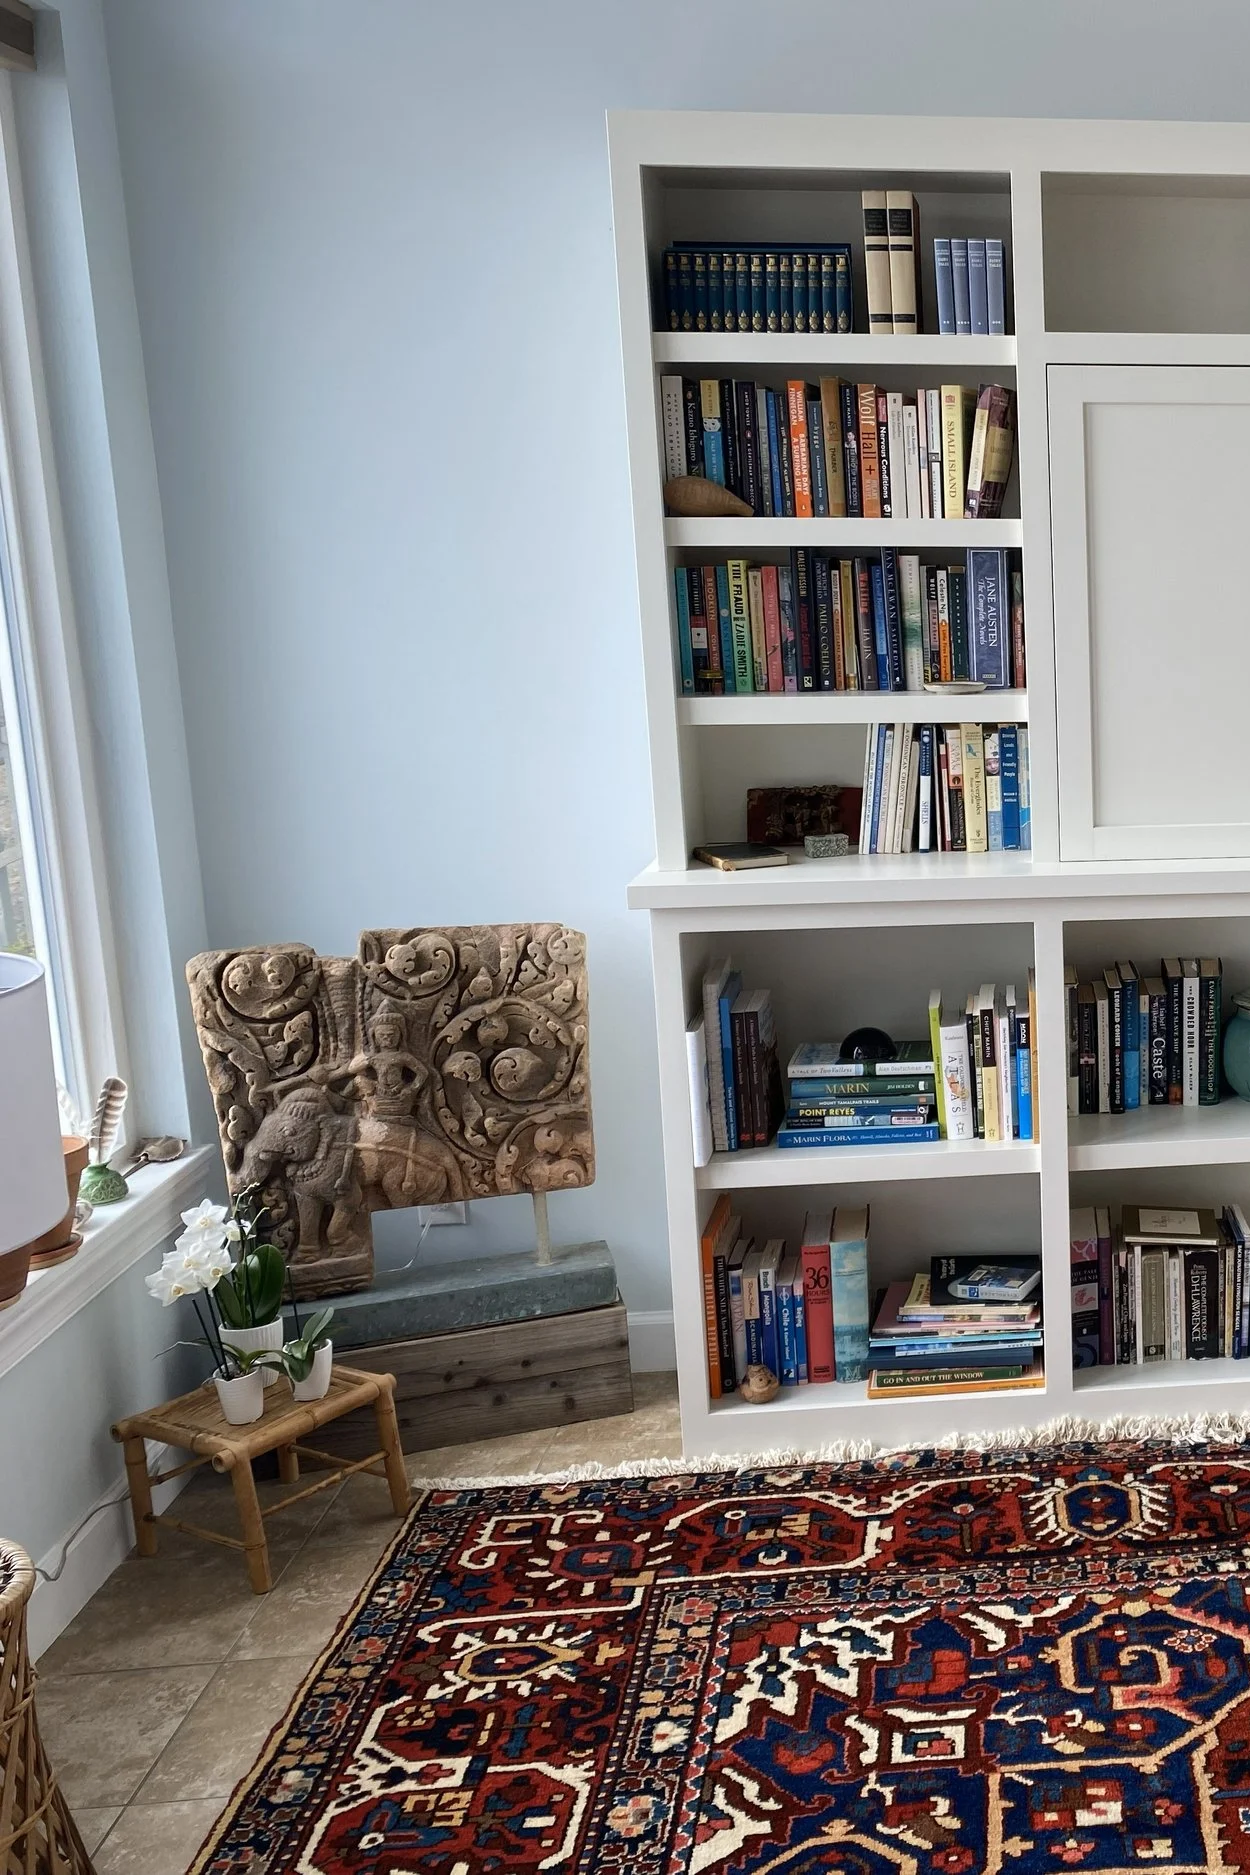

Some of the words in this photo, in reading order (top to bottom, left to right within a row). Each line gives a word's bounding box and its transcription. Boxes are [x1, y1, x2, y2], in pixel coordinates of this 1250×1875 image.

[687, 402, 696, 427] Kazuo
[790, 388, 798, 426] FINNEGAN
[796, 390, 804, 422] WILLIAM
[860, 390, 875, 426] Wolf
[688, 429, 698, 461] Ishiguro
[863, 432, 877, 460] Hall
[947, 420, 955, 457] SMALL
[793, 445, 801, 476] SURFING
[799, 433, 808, 475] BARBARIAN
[881, 459, 890, 499] Conditions
[948, 459, 957, 499] ISLAND
[732, 563, 741, 581] THE
[797, 551, 806, 571] KHALED
[885, 551, 893, 569] IAN
[706, 577, 715, 621] BROOKLYN
[798, 572, 807, 598] HOSSEINI
[887, 574, 896, 619] McEWAN
[977, 579, 985, 593] The
[985, 576, 996, 603] JANE
[733, 584, 744, 615] FRAUD
[939, 604, 947, 614] Ng
[976, 594, 986, 622] Complete
[819, 604, 828, 635] PAULO
[987, 605, 998, 647] AUSTEN
[736, 624, 746, 649] ZADIE
[979, 623, 987, 646] Novels
[737, 650, 748, 678] SMITH
[821, 636, 831, 676] COELHO
[891, 628, 900, 672] SATURDAY
[902, 735, 910, 770] DOMINICAN
[899, 772, 907, 806] CHRONICLE
[974, 780, 983, 816] Everglades
[921, 801, 929, 825] SHELLS
[1187, 996, 1196, 1029] CROWDED
[1187, 1031, 1196, 1049] HOUR
[1152, 1037, 1166, 1080] Caste
[825, 1082, 870, 1094] MARIN
[948, 1055, 961, 1113] ATLAS
[799, 1108, 827, 1117] POINT
[829, 1107, 855, 1116] REYES
[793, 1136, 821, 1144] MARIN
[823, 1135, 851, 1143] FLORA
[717, 1258, 725, 1272] THE
[806, 1266, 830, 1290] 36
[718, 1272, 726, 1296] WHITE
[762, 1271, 770, 1289] Bradt
[704, 1273, 715, 1320] DOMINICAN
[719, 1298, 727, 1315] NILE
[763, 1294, 772, 1326] Mongolia
[733, 1299, 744, 1334] JAPAN
[782, 1308, 791, 1326] Chile
[795, 1306, 803, 1328] Beijing
[708, 1327, 718, 1367] REPUBLIC
[1201, 1333, 1207, 1341] OF
[883, 1377, 893, 1385] GO
[938, 1373, 952, 1381] THE
[954, 1371, 984, 1379] WINDOW
